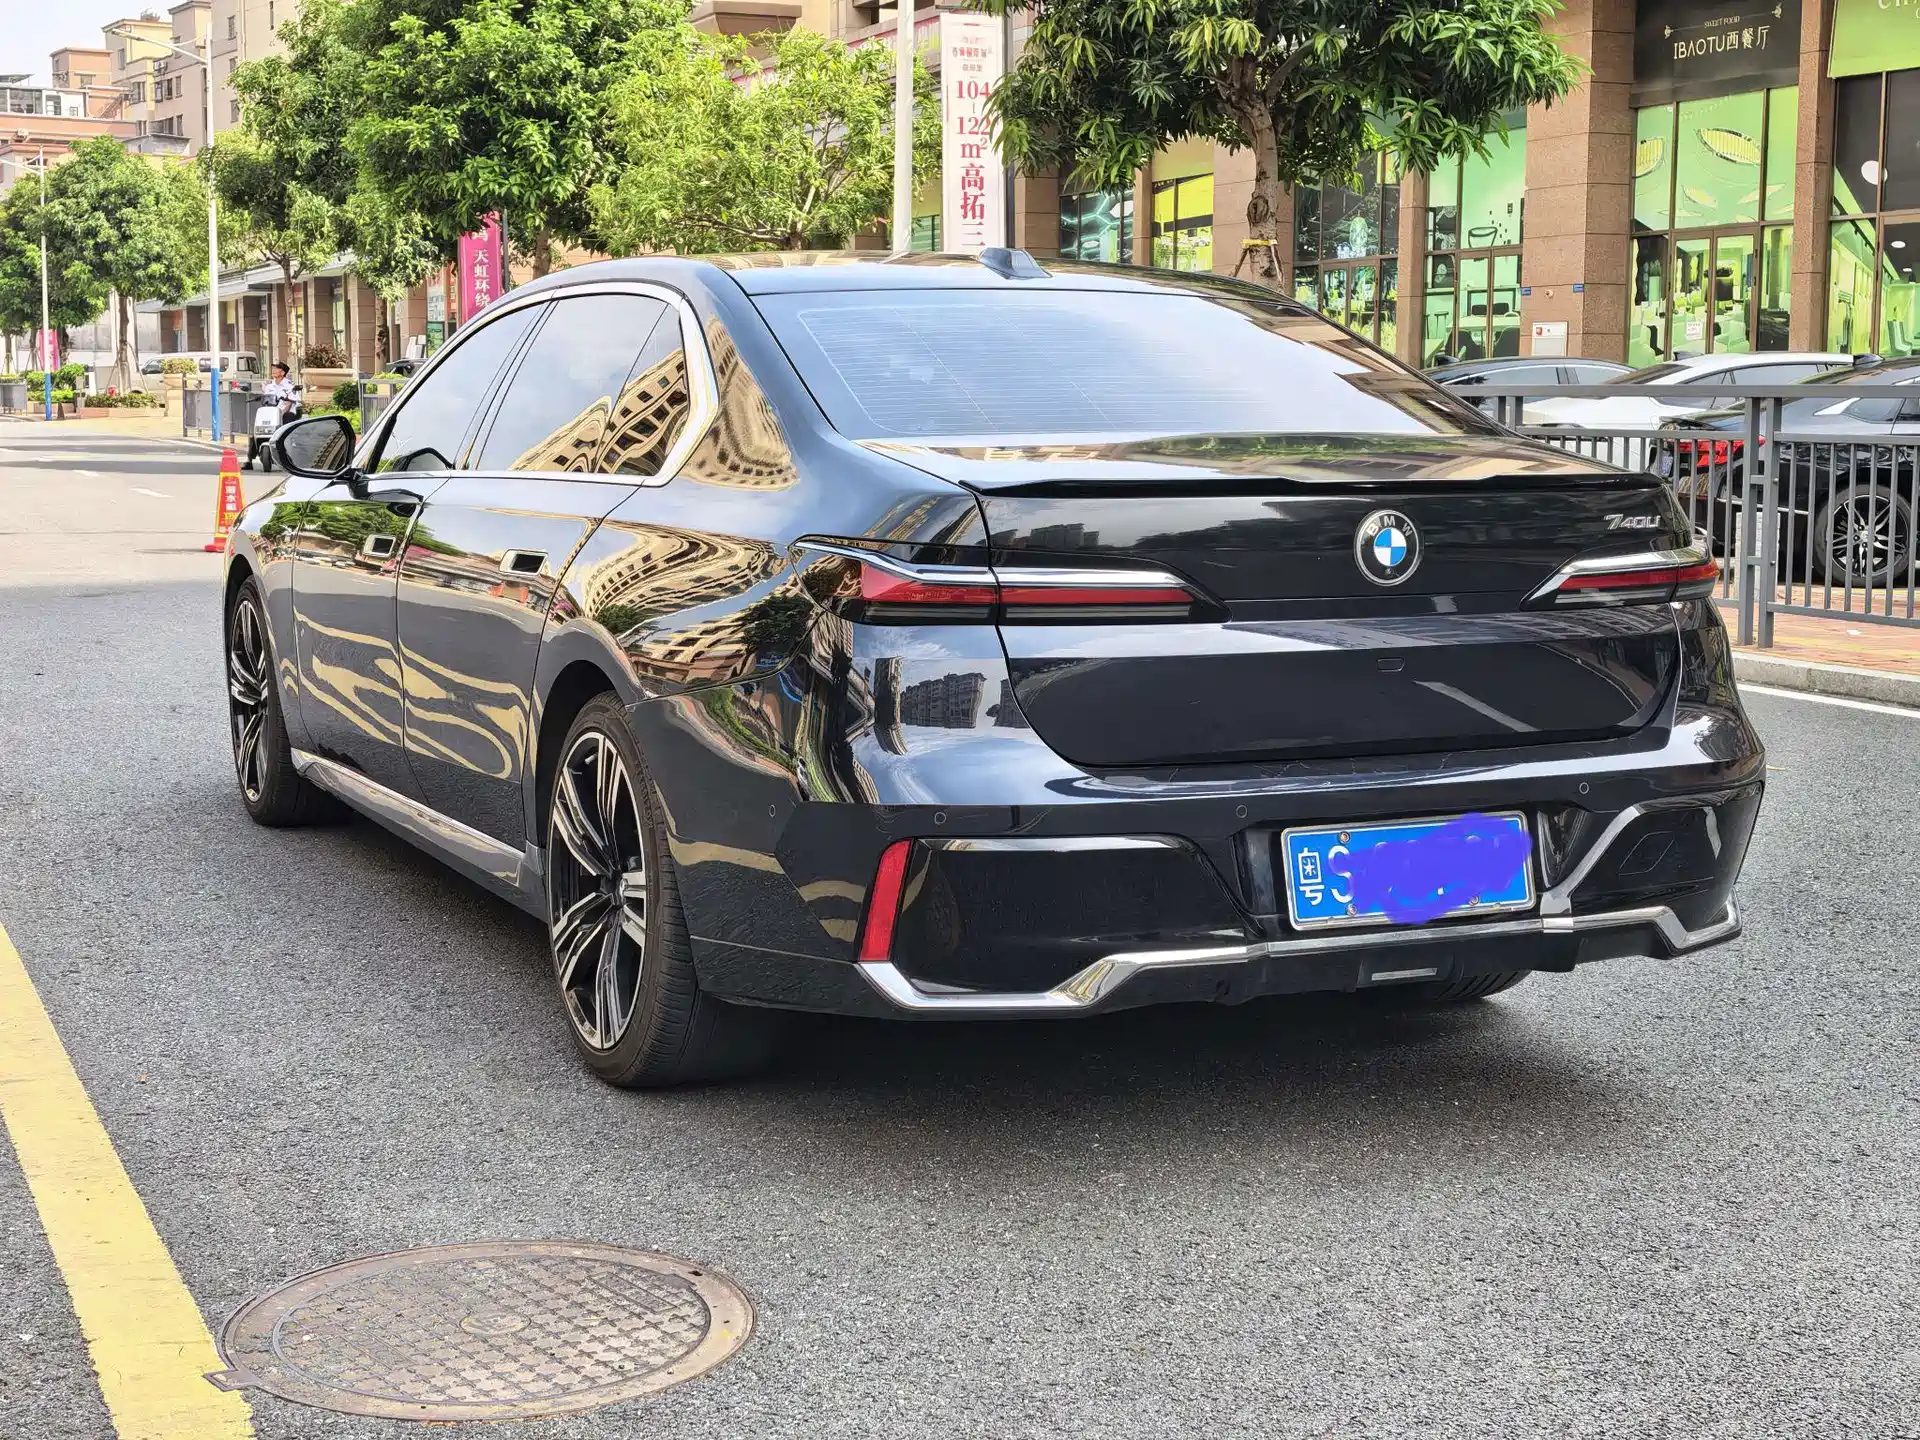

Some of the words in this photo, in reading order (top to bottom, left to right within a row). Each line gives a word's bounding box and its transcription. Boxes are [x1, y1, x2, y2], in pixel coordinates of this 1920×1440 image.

[956, 80, 990, 100] 104
[956, 116, 991, 136] 122
[1366, 515, 1413, 537] BMW
